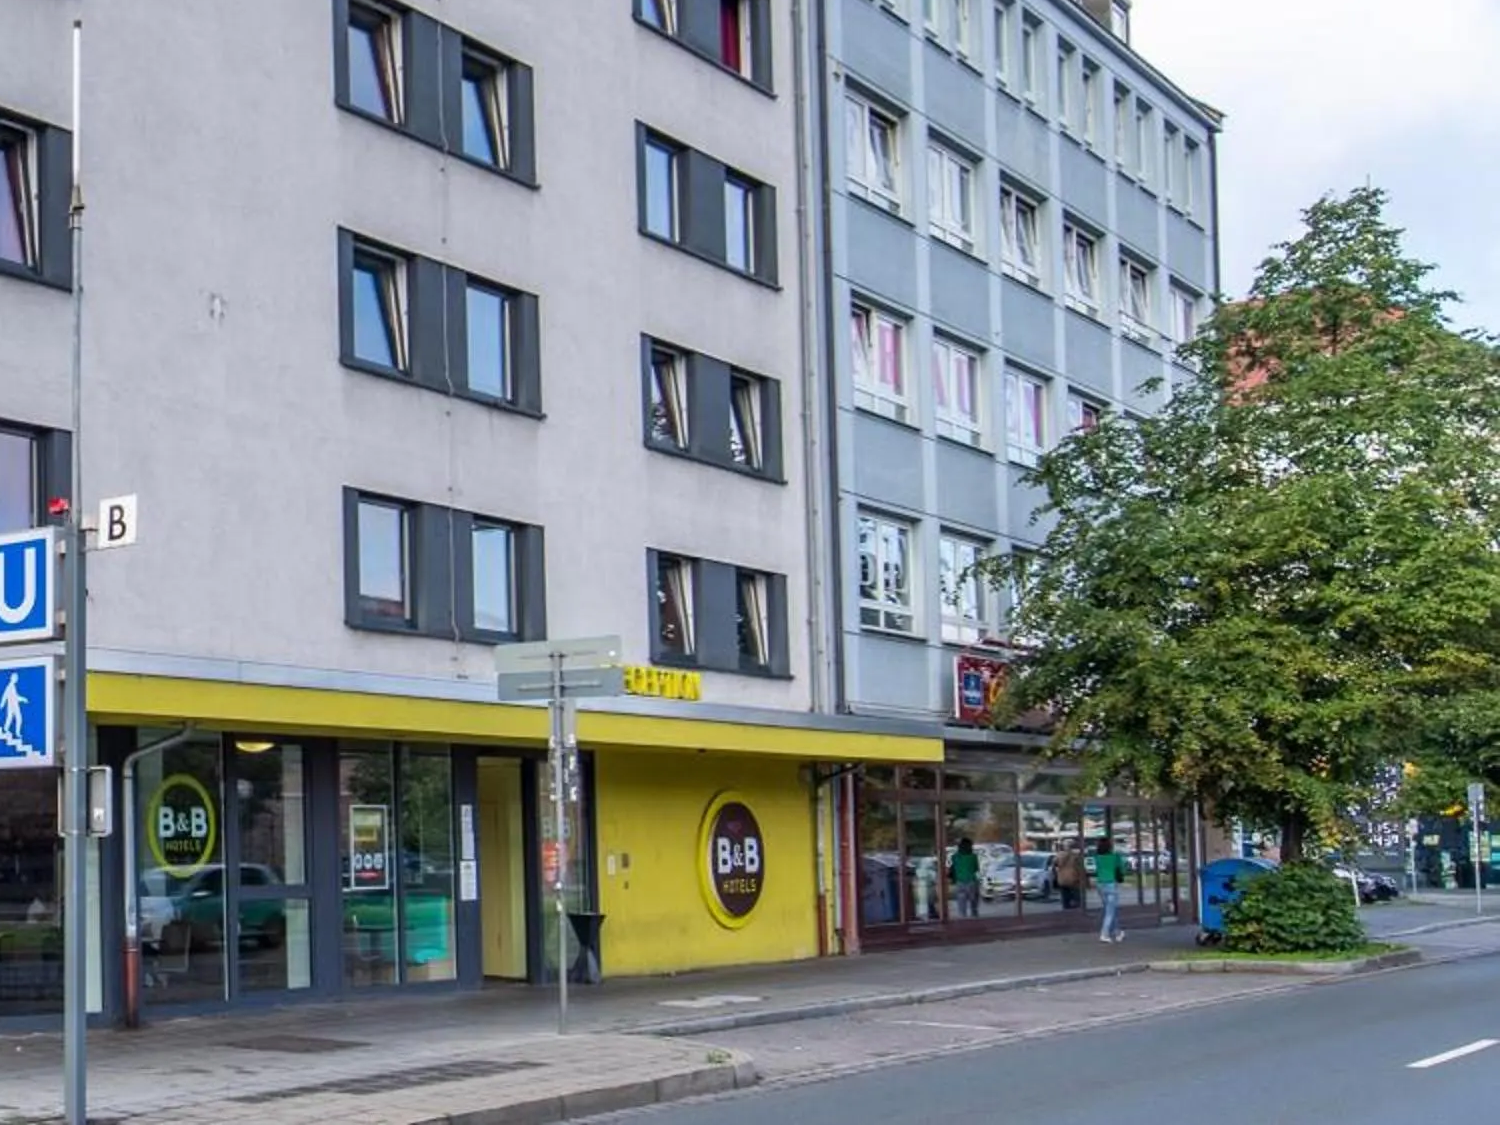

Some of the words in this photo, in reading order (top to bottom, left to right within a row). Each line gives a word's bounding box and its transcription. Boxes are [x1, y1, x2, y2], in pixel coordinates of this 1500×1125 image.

[107, 504, 127, 541] B
[159, 806, 208, 838] B&B
[717, 837, 759, 874] B&B
[723, 877, 756, 893] HOTELS
